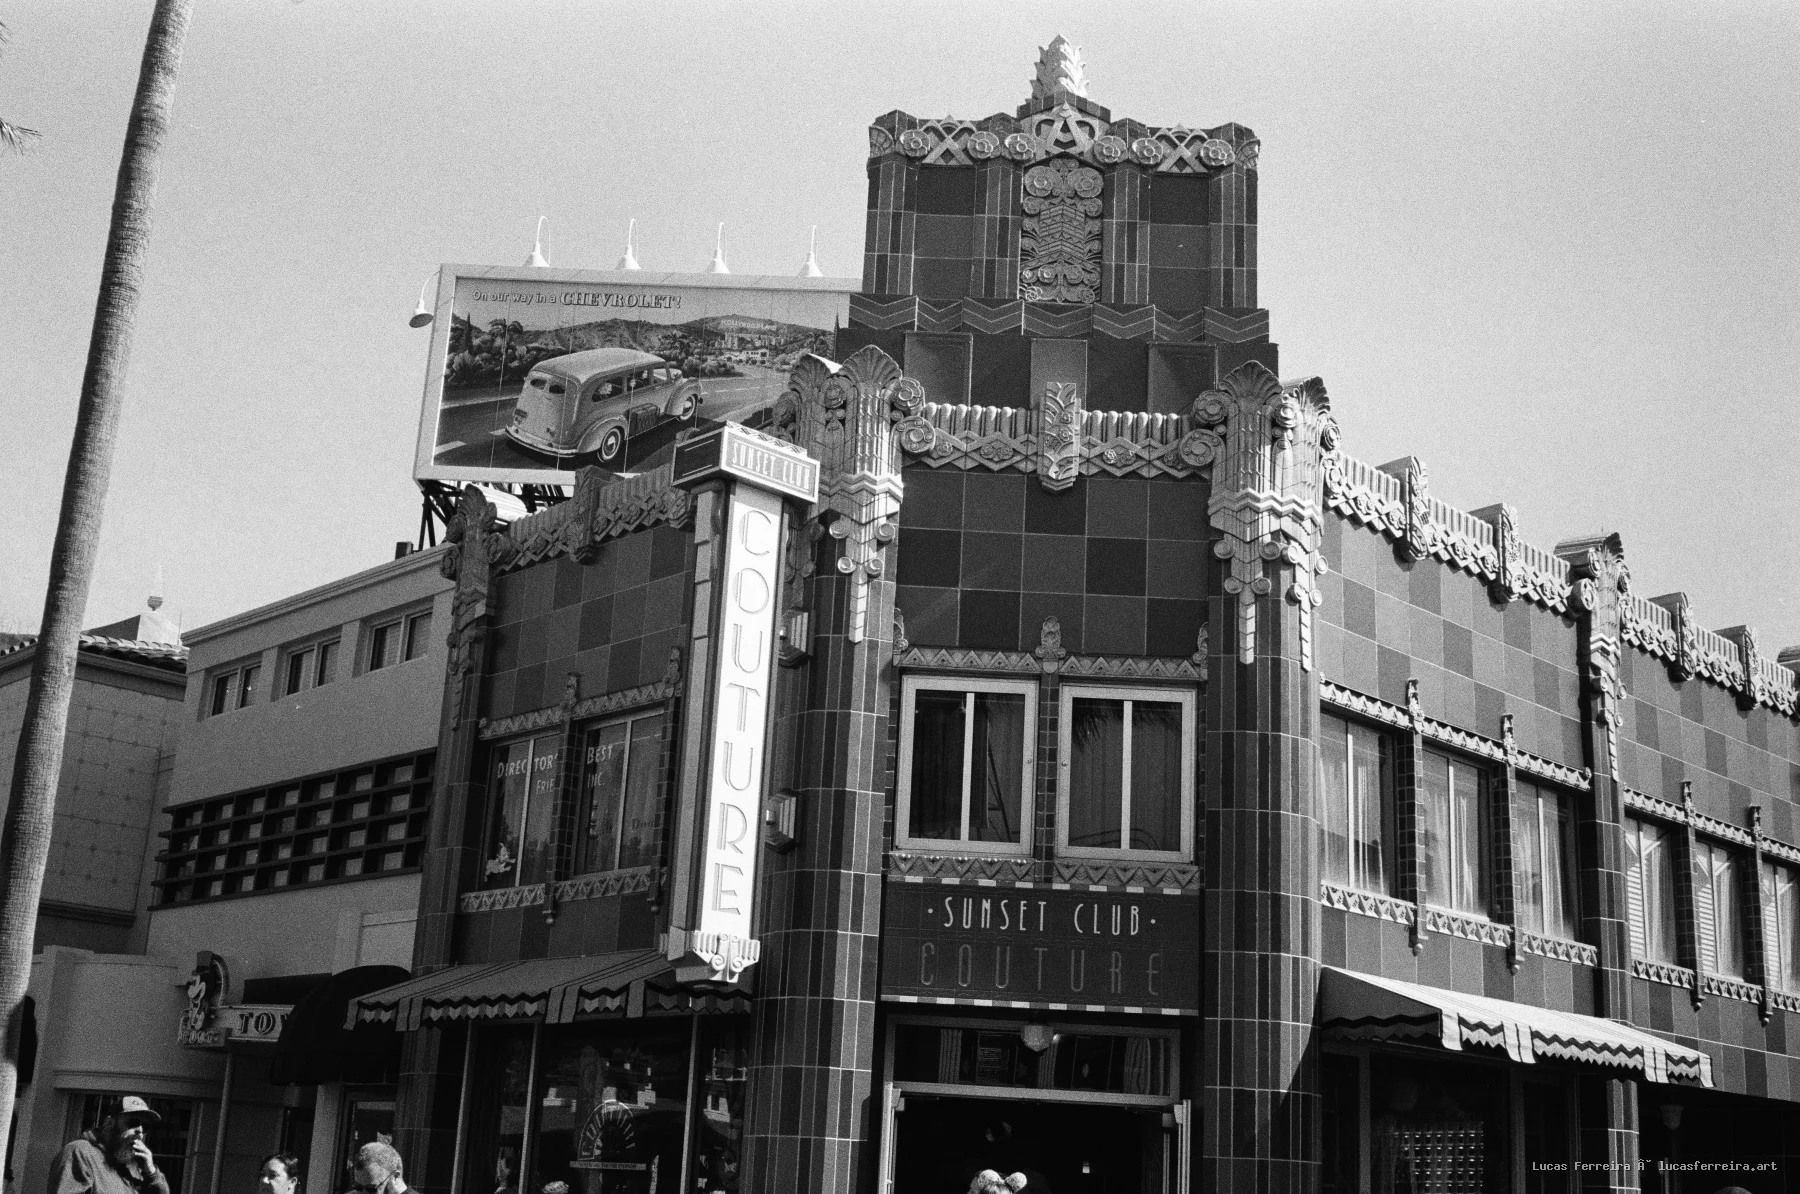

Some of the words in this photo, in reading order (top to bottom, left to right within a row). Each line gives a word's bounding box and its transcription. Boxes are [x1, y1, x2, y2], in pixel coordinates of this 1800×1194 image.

[472, 289, 488, 302] On
[491, 292, 510, 302] our
[511, 293, 534, 305] way
[535, 291, 547, 303] in
[550, 295, 557, 303] a
[560, 291, 682, 309] CHEVROLET!
[732, 442, 776, 478] SUNSET
[783, 461, 811, 490] CLUB
[711, 509, 772, 916] COUTURE
[587, 745, 614, 765] BEST
[944, 896, 1047, 932] SUNSET
[1074, 903, 1139, 936] CLUB
[920, 941, 1160, 996] COUTURE
